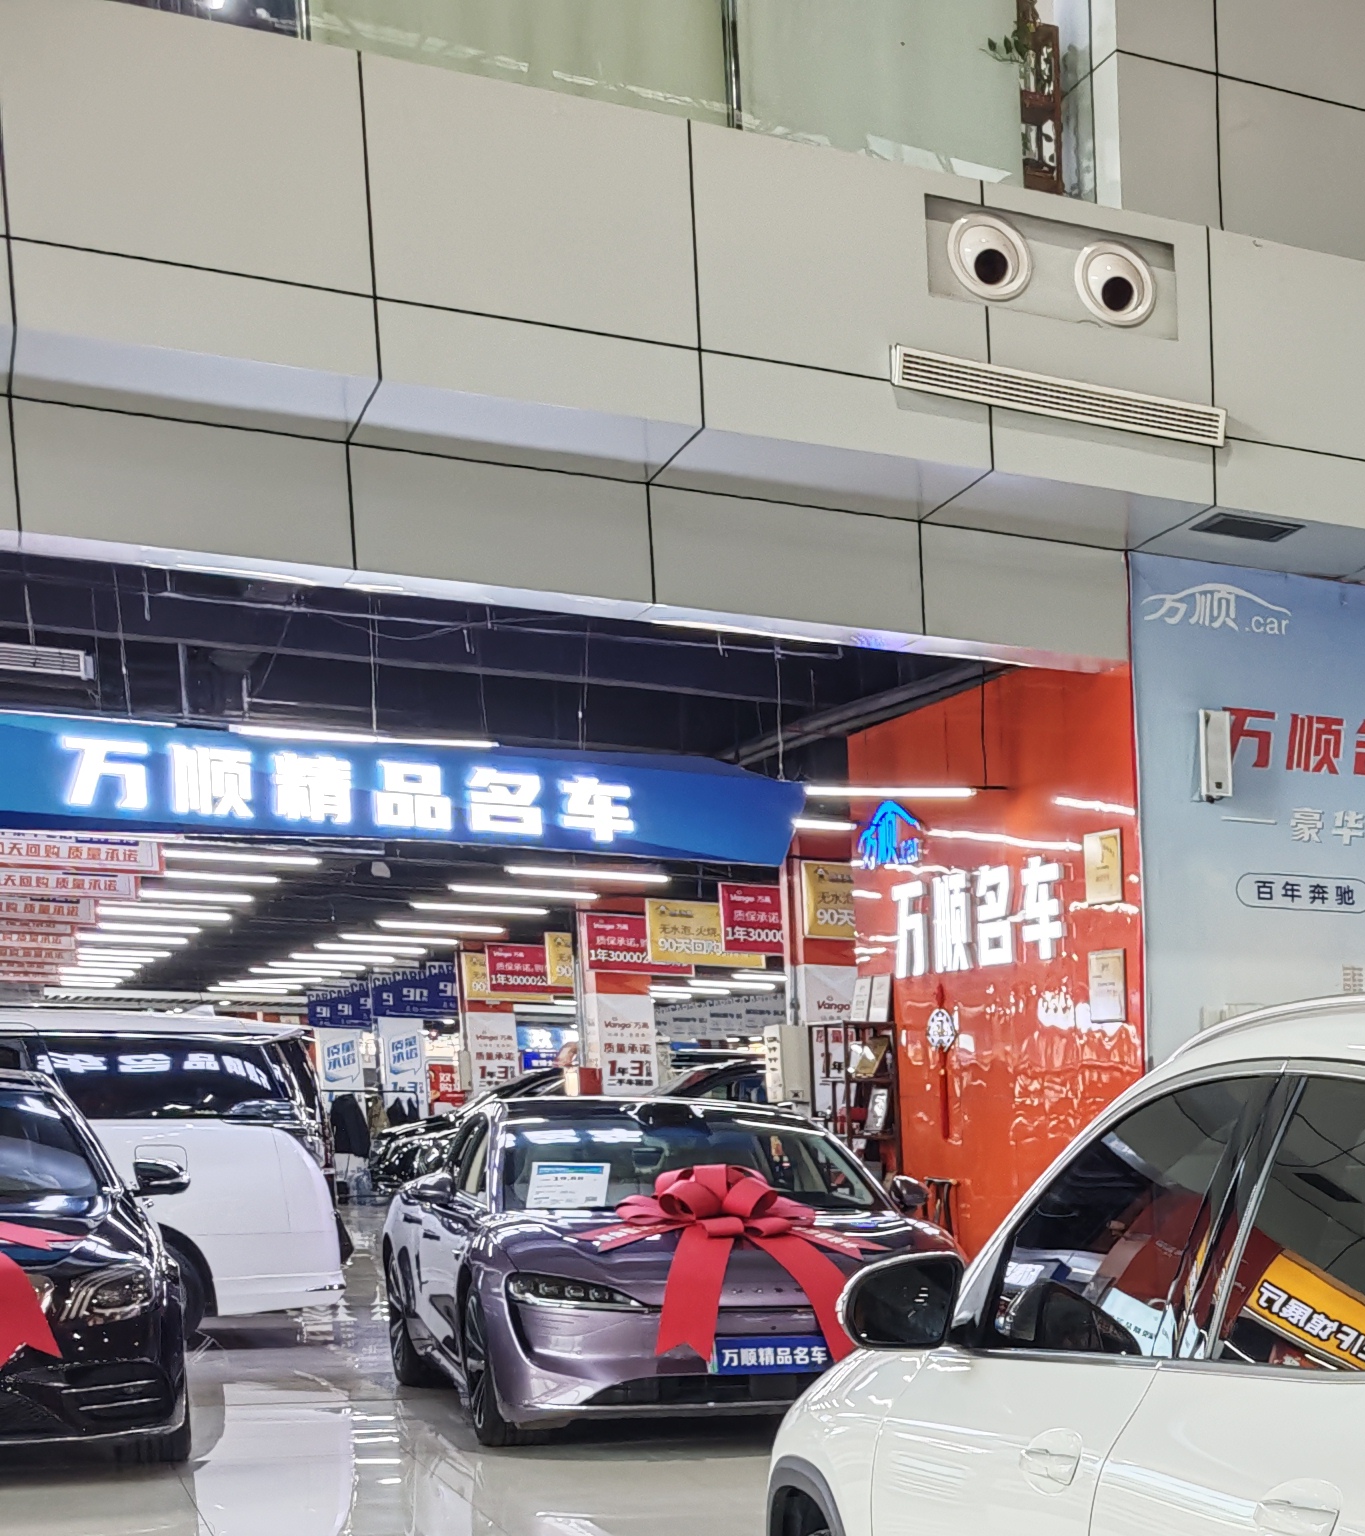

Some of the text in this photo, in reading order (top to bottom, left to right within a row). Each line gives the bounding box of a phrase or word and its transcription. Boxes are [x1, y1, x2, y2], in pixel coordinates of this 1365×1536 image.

[1142, 585, 1241, 632] 万顺
[60, 735, 637, 843] 万顺精品名车
[67, 845, 140, 863] 质量承诺
[55, 876, 118, 892] 质量承诺
[1255, 879, 1357, 908] 百年奔驰
[891, 855, 1066, 980] 万顺名车
[721, 1345, 829, 1368] 万顺精品名车
